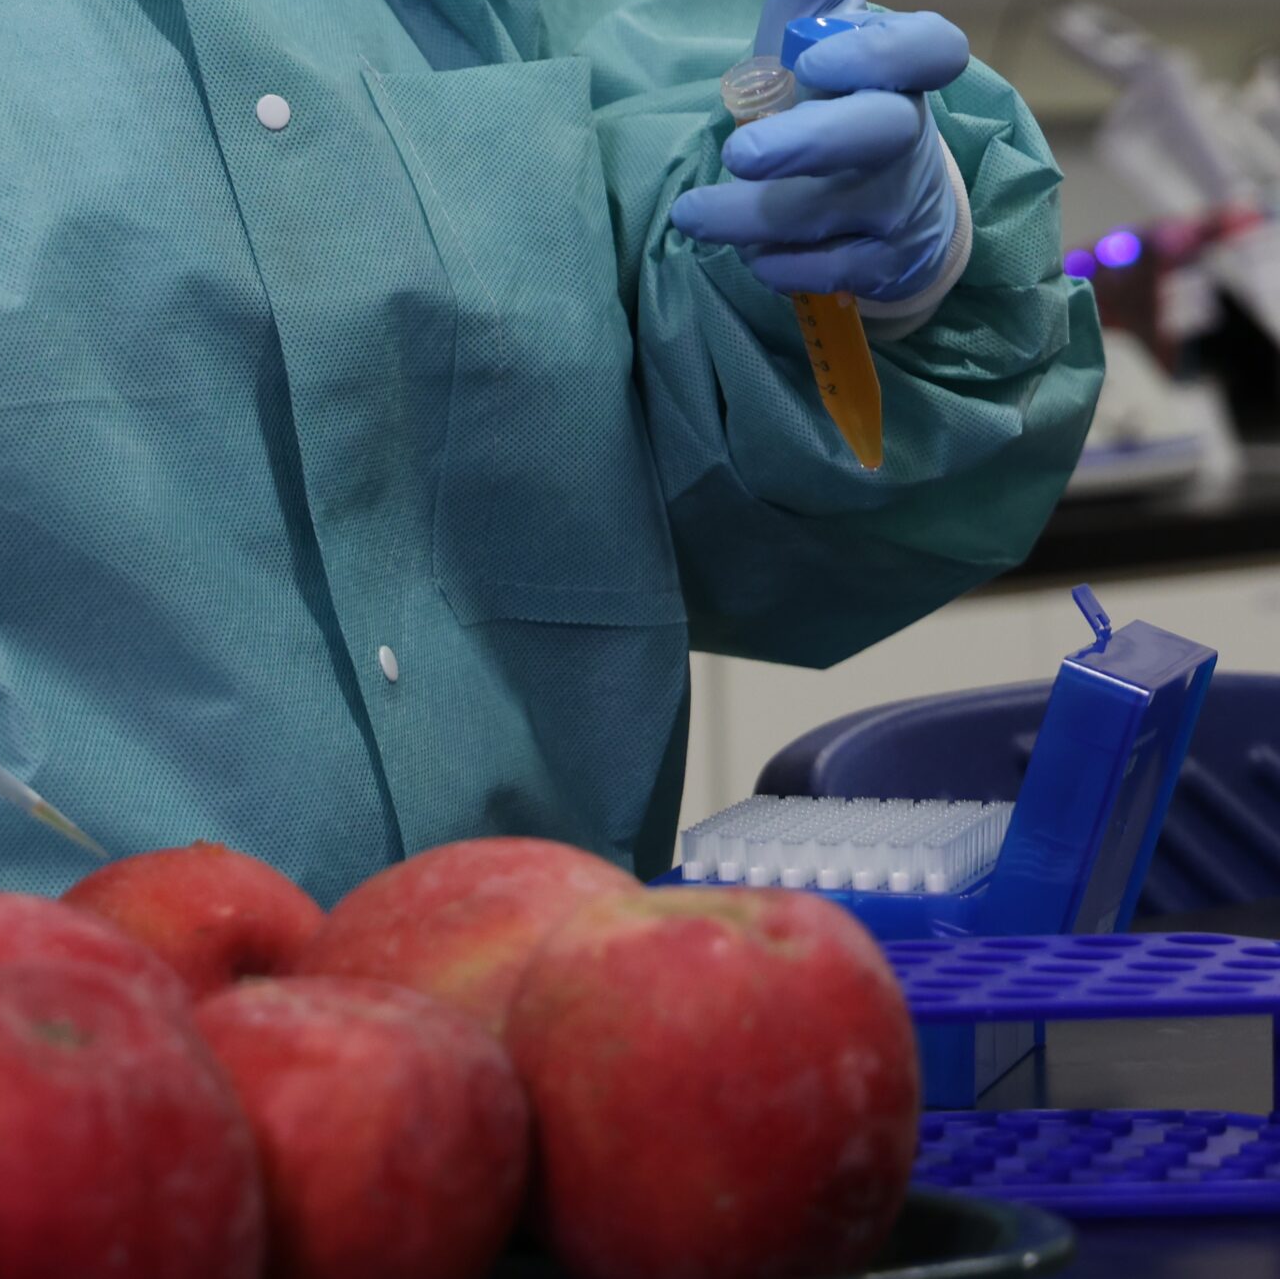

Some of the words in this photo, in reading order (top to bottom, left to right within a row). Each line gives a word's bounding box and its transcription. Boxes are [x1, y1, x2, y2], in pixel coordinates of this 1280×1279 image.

[814, 337, 823, 349] 4
[821, 360, 830, 372] 3
[826, 383, 837, 395] 2
